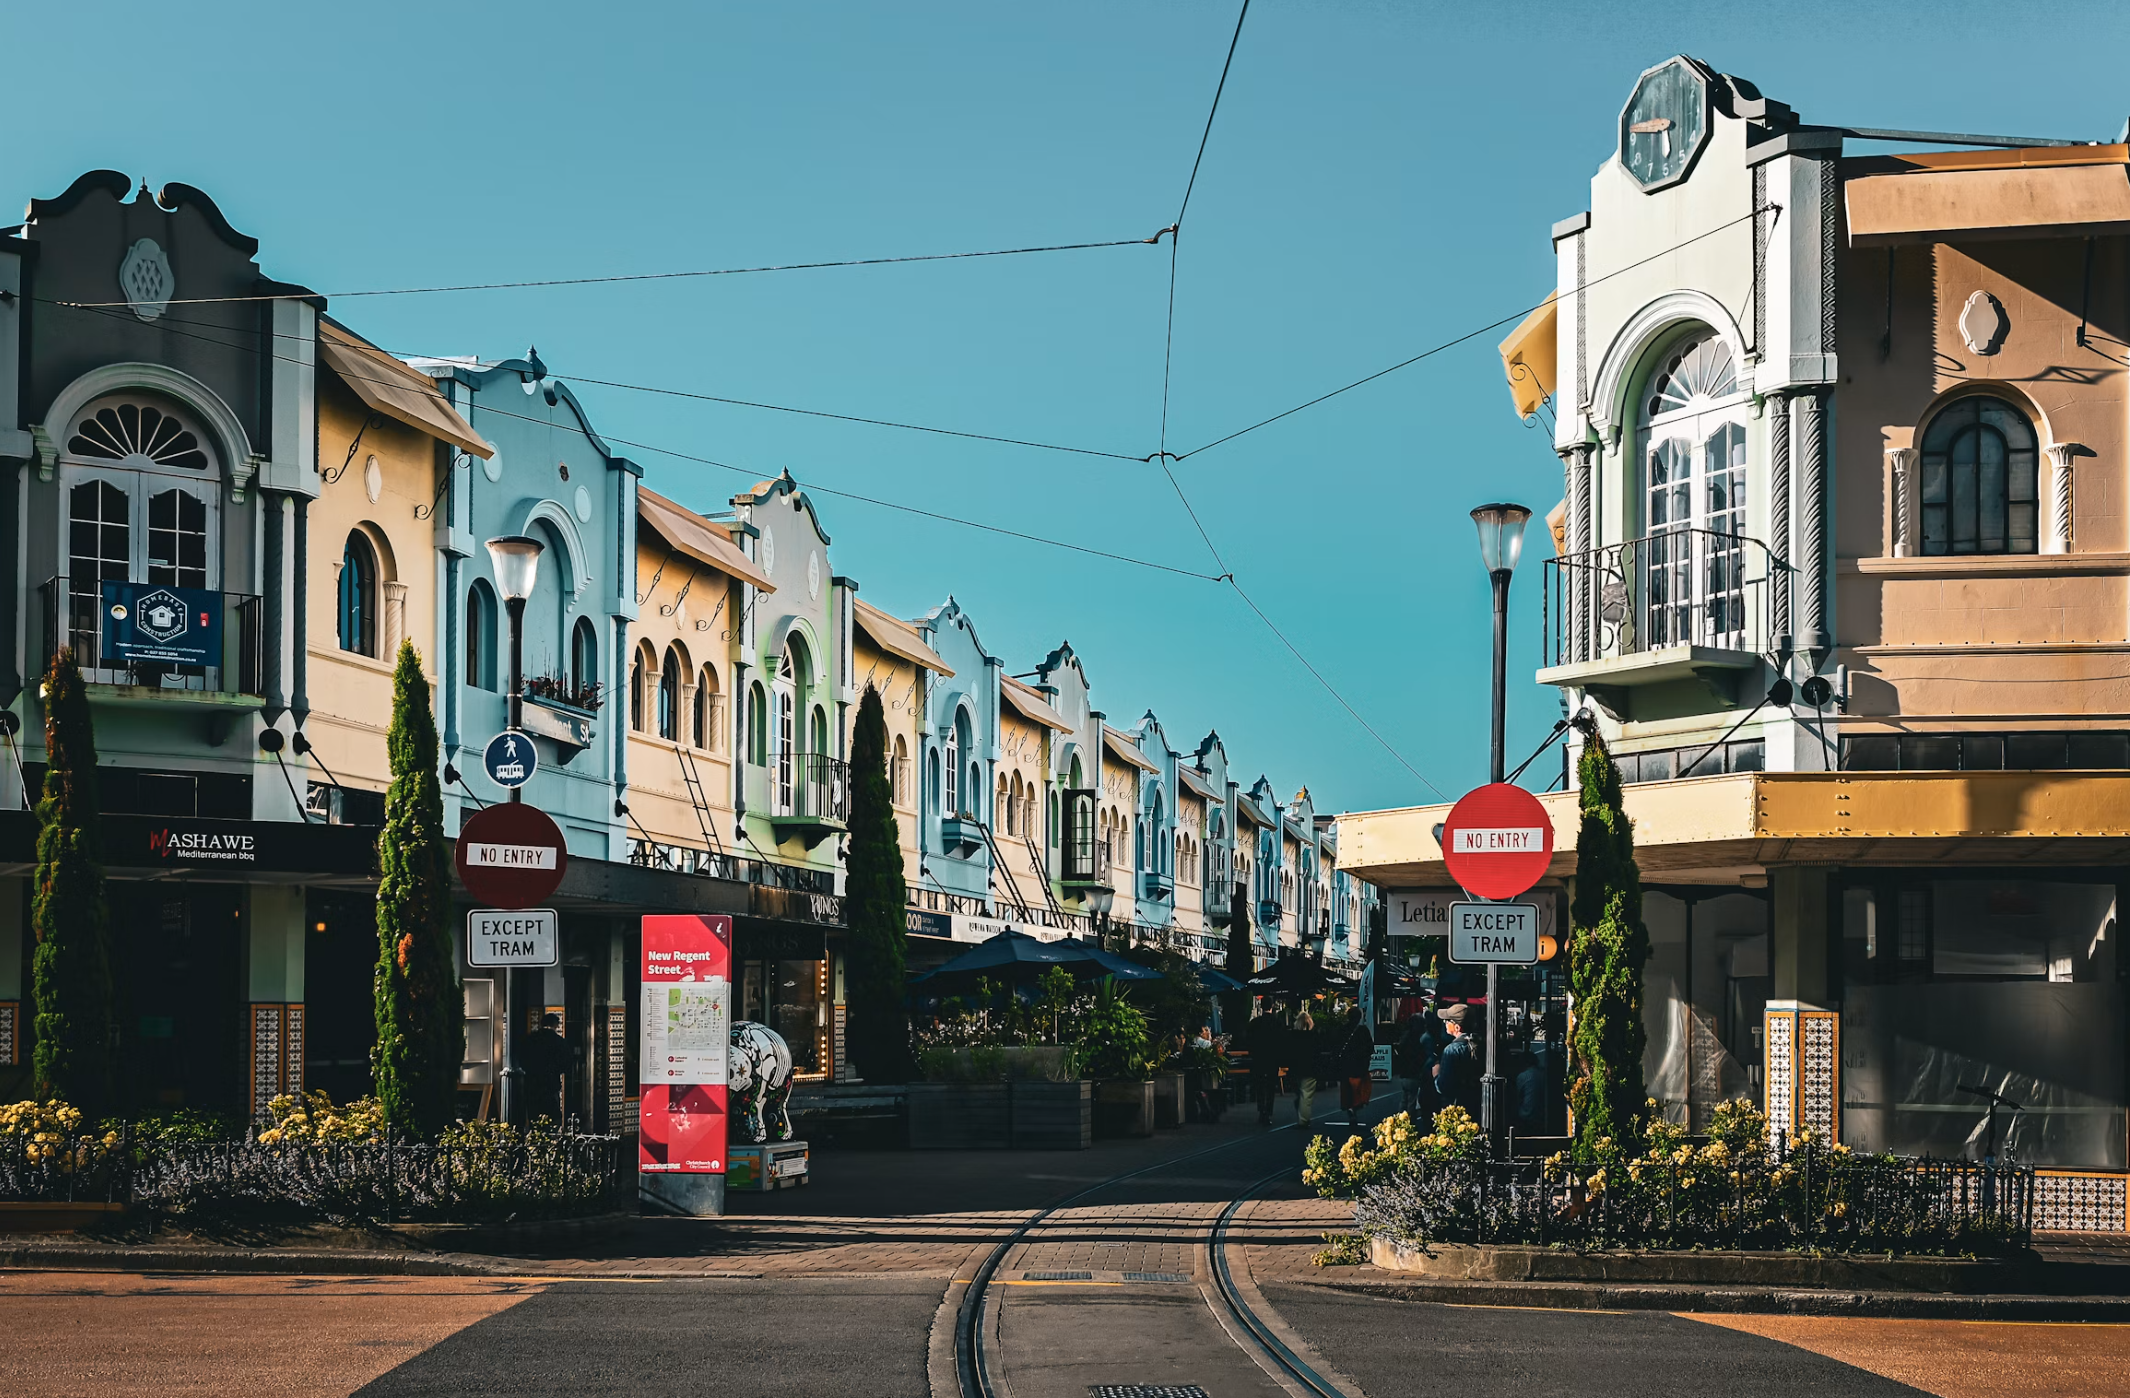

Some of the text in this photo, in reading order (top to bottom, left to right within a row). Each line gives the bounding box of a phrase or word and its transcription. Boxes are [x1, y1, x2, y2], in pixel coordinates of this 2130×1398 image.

[141, 595, 183, 612] HOMEBASE
[140, 621, 183, 637] CONSTRUCTION
[580, 723, 591, 743] St
[150, 829, 255, 857] MASHAWE
[1466, 832, 1529, 848] NO ENTRY
[177, 849, 255, 861] Mediterranean bbq
[480, 848, 543, 865] NO ENTRY
[1401, 900, 1449, 923] Letia
[482, 920, 544, 936] EXCEPT
[905, 912, 922, 931] OOR
[1463, 913, 1525, 931] EXCEPT
[490, 941, 535, 956] TRAM
[1471, 936, 1516, 953] TRAM
[648, 951, 711, 963] New Regent
[648, 964, 682, 975] Street
